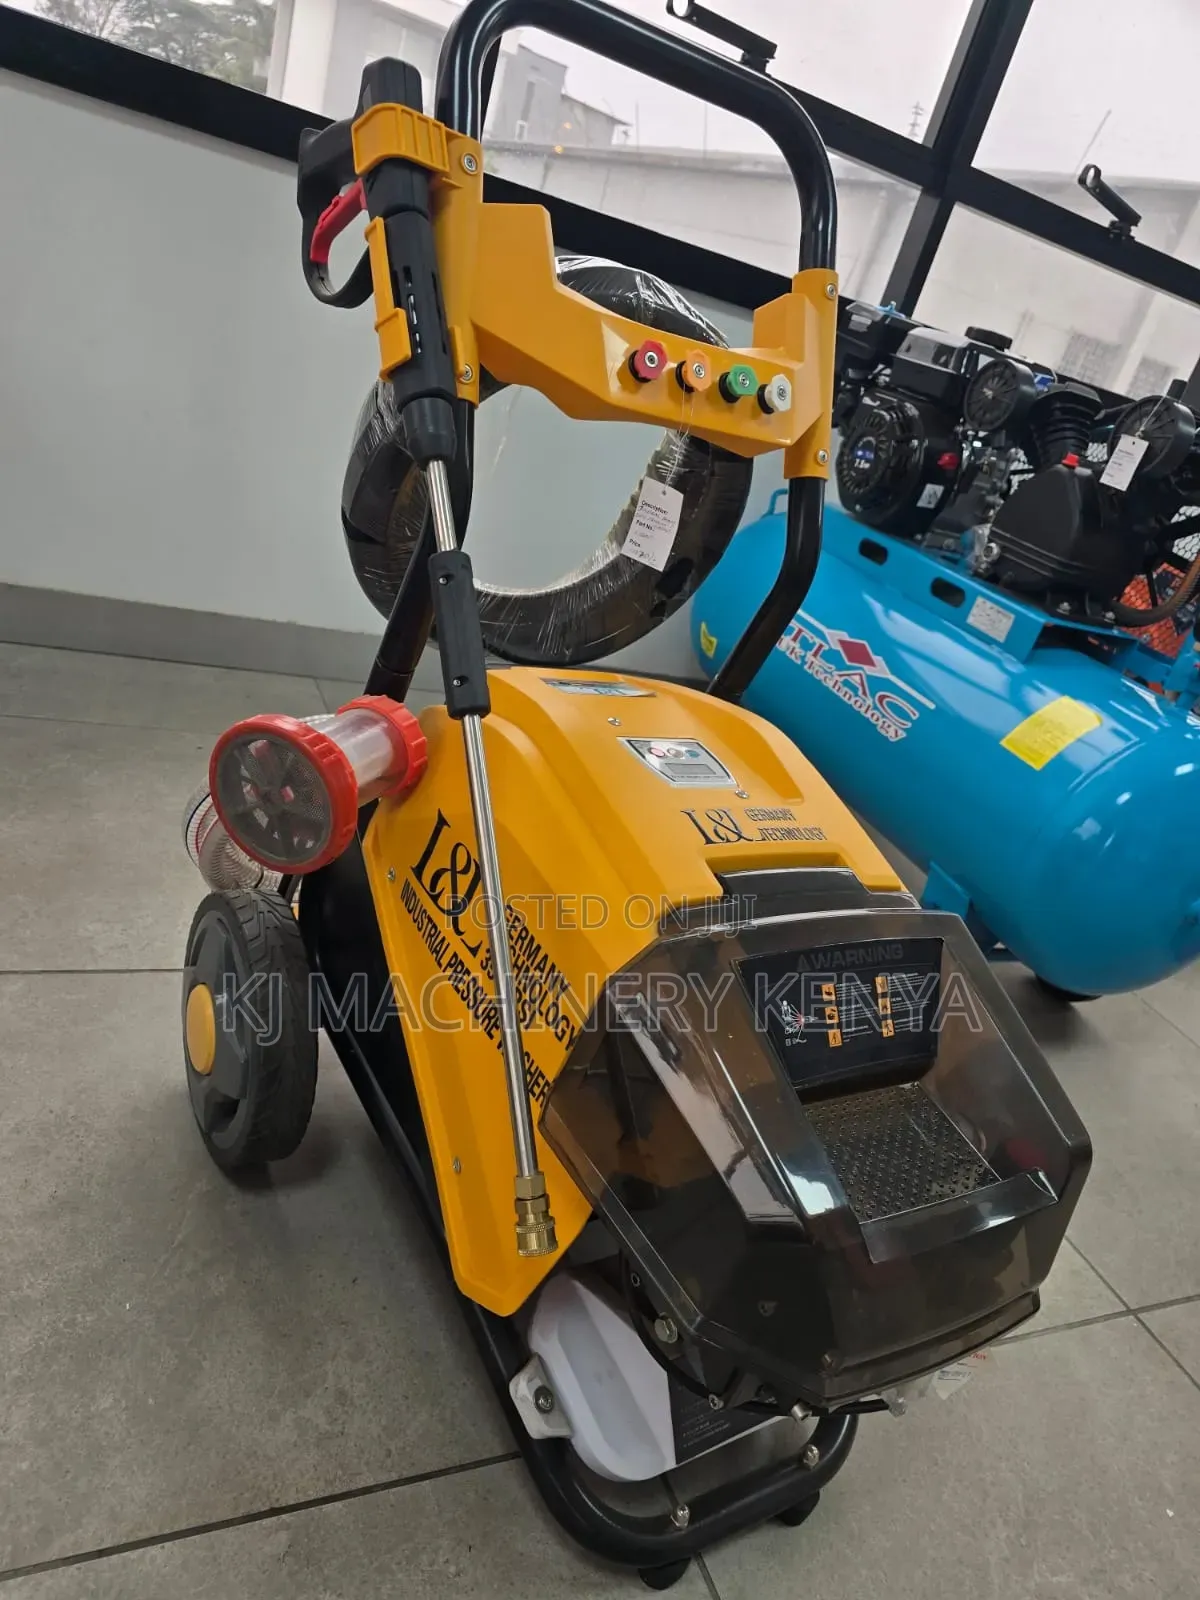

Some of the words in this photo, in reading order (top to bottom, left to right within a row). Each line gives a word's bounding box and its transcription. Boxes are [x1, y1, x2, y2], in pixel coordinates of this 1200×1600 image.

[804, 654, 907, 742] Technology
[743, 808, 797, 822] GERMANY
[757, 827, 828, 842] TECHNOLOGY
[400, 877, 451, 970] INDUSTRIAL
[442, 951, 501, 1041] PRESSURE
[810, 943, 904, 970] WARNING
